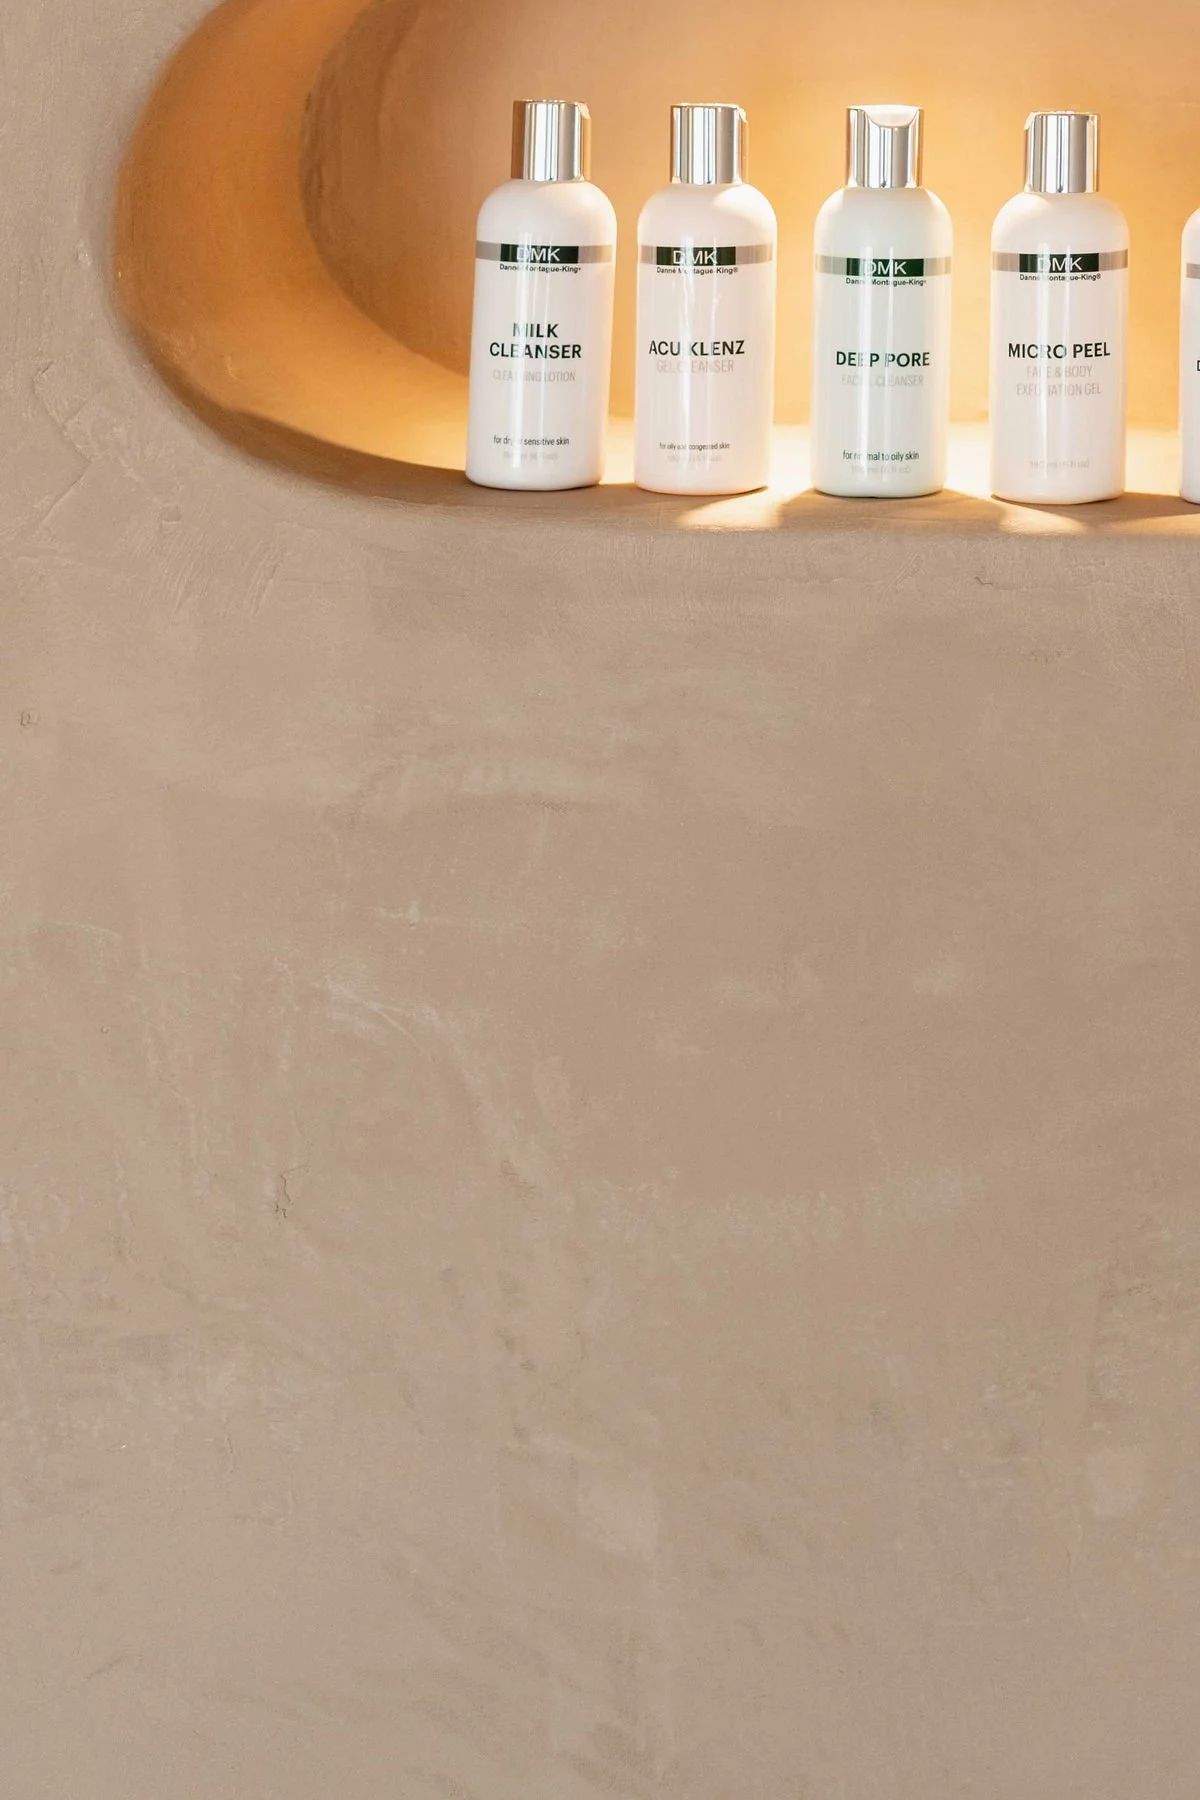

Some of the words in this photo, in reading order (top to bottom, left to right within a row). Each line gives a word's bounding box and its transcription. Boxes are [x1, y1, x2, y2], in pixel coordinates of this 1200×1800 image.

[516, 247, 561, 261] DMK
[864, 261, 907, 275] DMK
[1037, 257, 1083, 271] DMK
[846, 277, 865, 285] Dann
[512, 321, 560, 339] MILK
[489, 342, 582, 359] CLEANSER
[1008, 343, 1067, 359] MICRO
[1073, 341, 1111, 358] PEEL
[656, 360, 678, 374] GEL
[679, 359, 735, 374] CEANSER
[836, 351, 880, 367] DEEP
[884, 351, 931, 368] PORE
[492, 369, 541, 383] CLEAING
[544, 370, 576, 383] LOTION
[1064, 364, 1093, 378] BODY
[876, 374, 924, 388] CLEANSER
[1016, 383, 1082, 397] EXFOIATION
[1084, 382, 1102, 395] GEL
[493, 434, 503, 444] for
[524, 436, 555, 446] sensitive
[555, 435, 570, 445] skin
[842, 450, 853, 460] for
[854, 451, 880, 461] nmal
[891, 452, 904, 463] oily
[905, 450, 920, 460] skin
